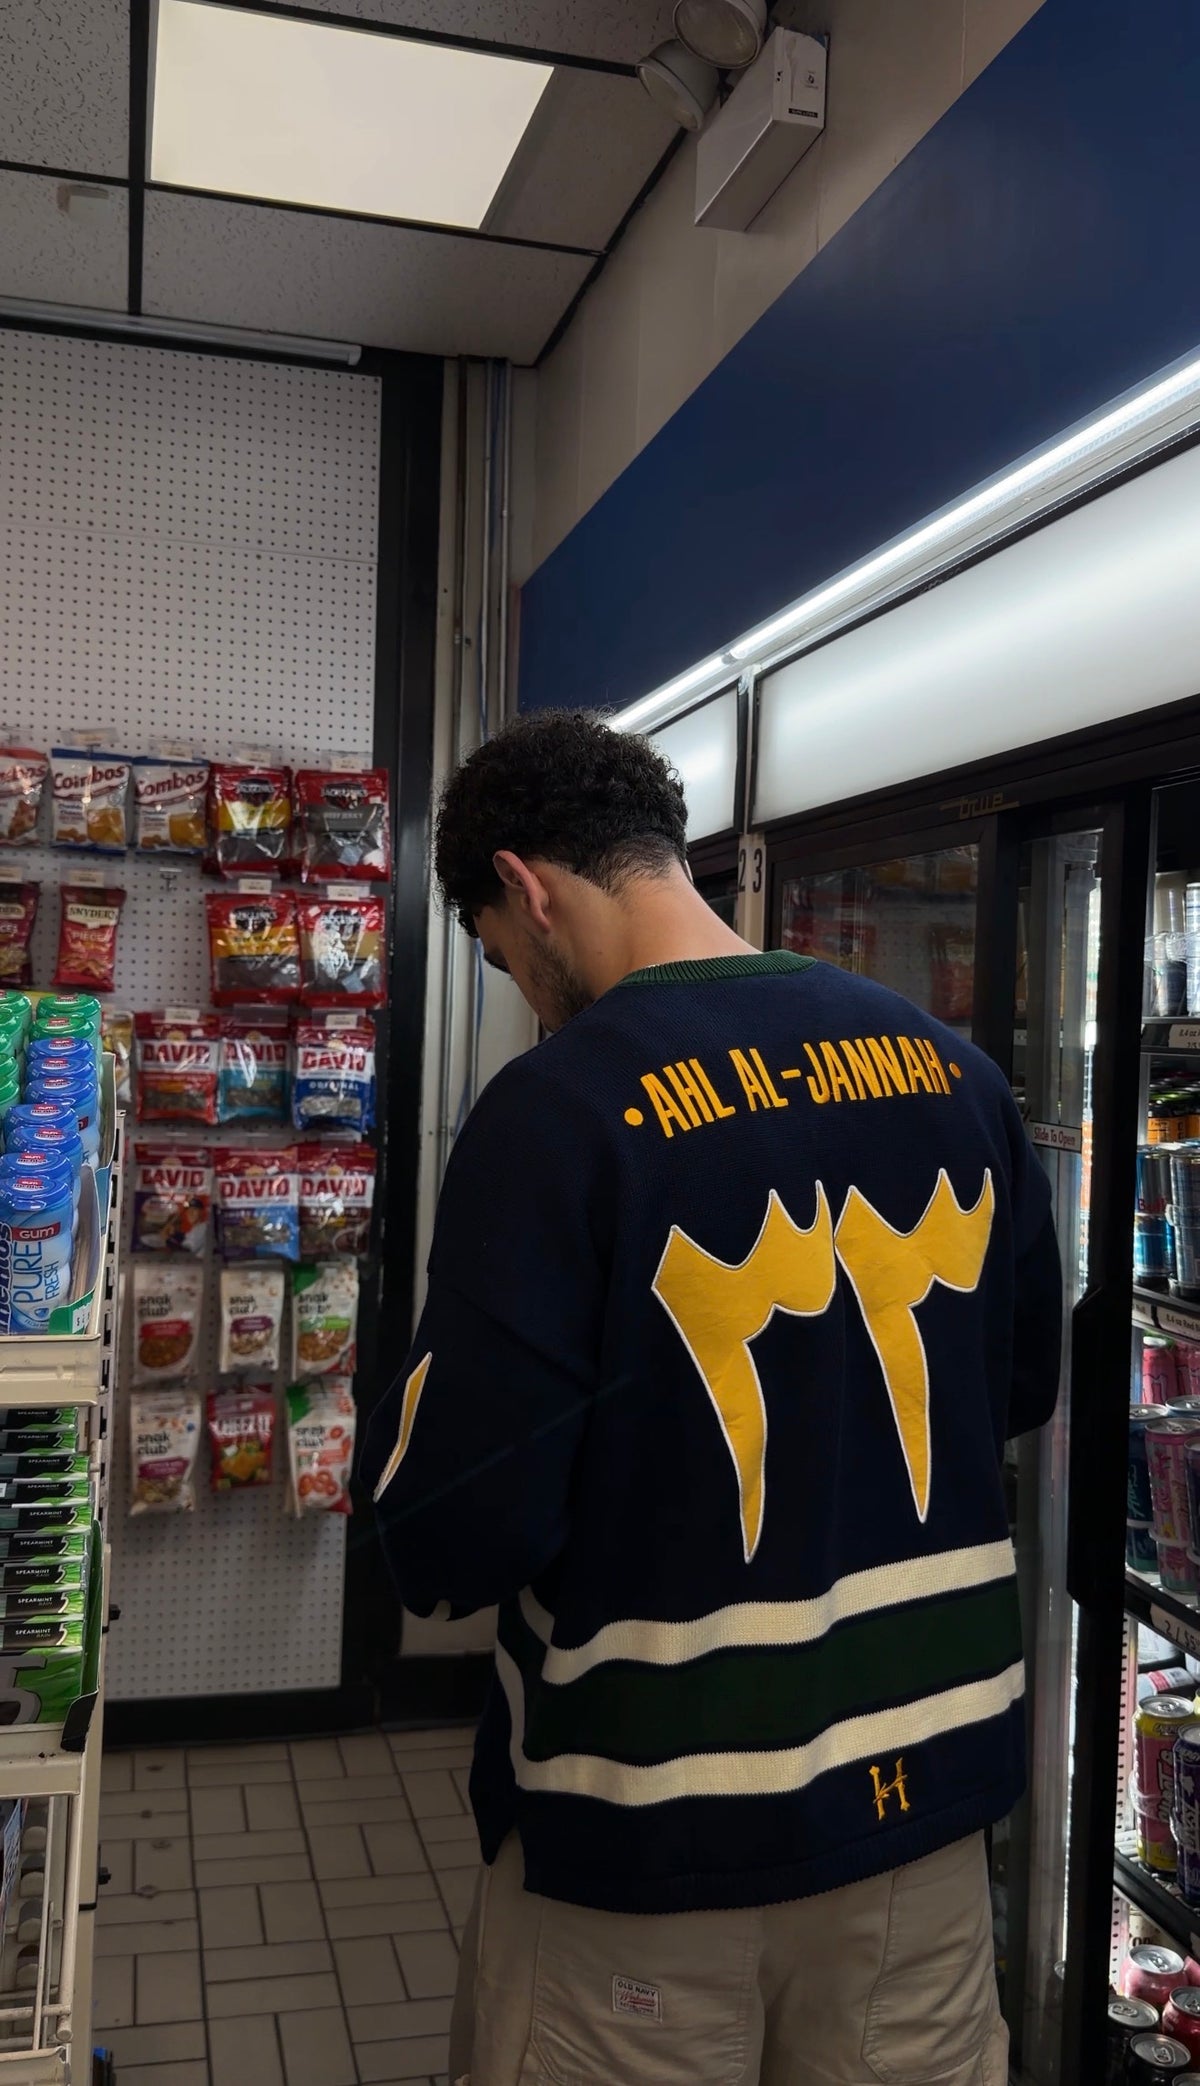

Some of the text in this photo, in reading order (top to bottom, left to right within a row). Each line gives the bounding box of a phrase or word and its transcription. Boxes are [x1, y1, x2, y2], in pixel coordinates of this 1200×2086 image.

[640, 1036, 952, 1138] AHL AL-JANNAH
[1034, 1126, 1075, 1147] Slide To Open
[220, 1176, 290, 1199] DAVID
[300, 1177, 367, 1198] DAVID
[13, 1241, 43, 1302] PURE
[43, 1260, 60, 1301] FRESH
[15, 1628, 51, 1636] SPEARMINT
[617, 1980, 634, 1991] OLD
[634, 1986, 656, 1998] NAVY
